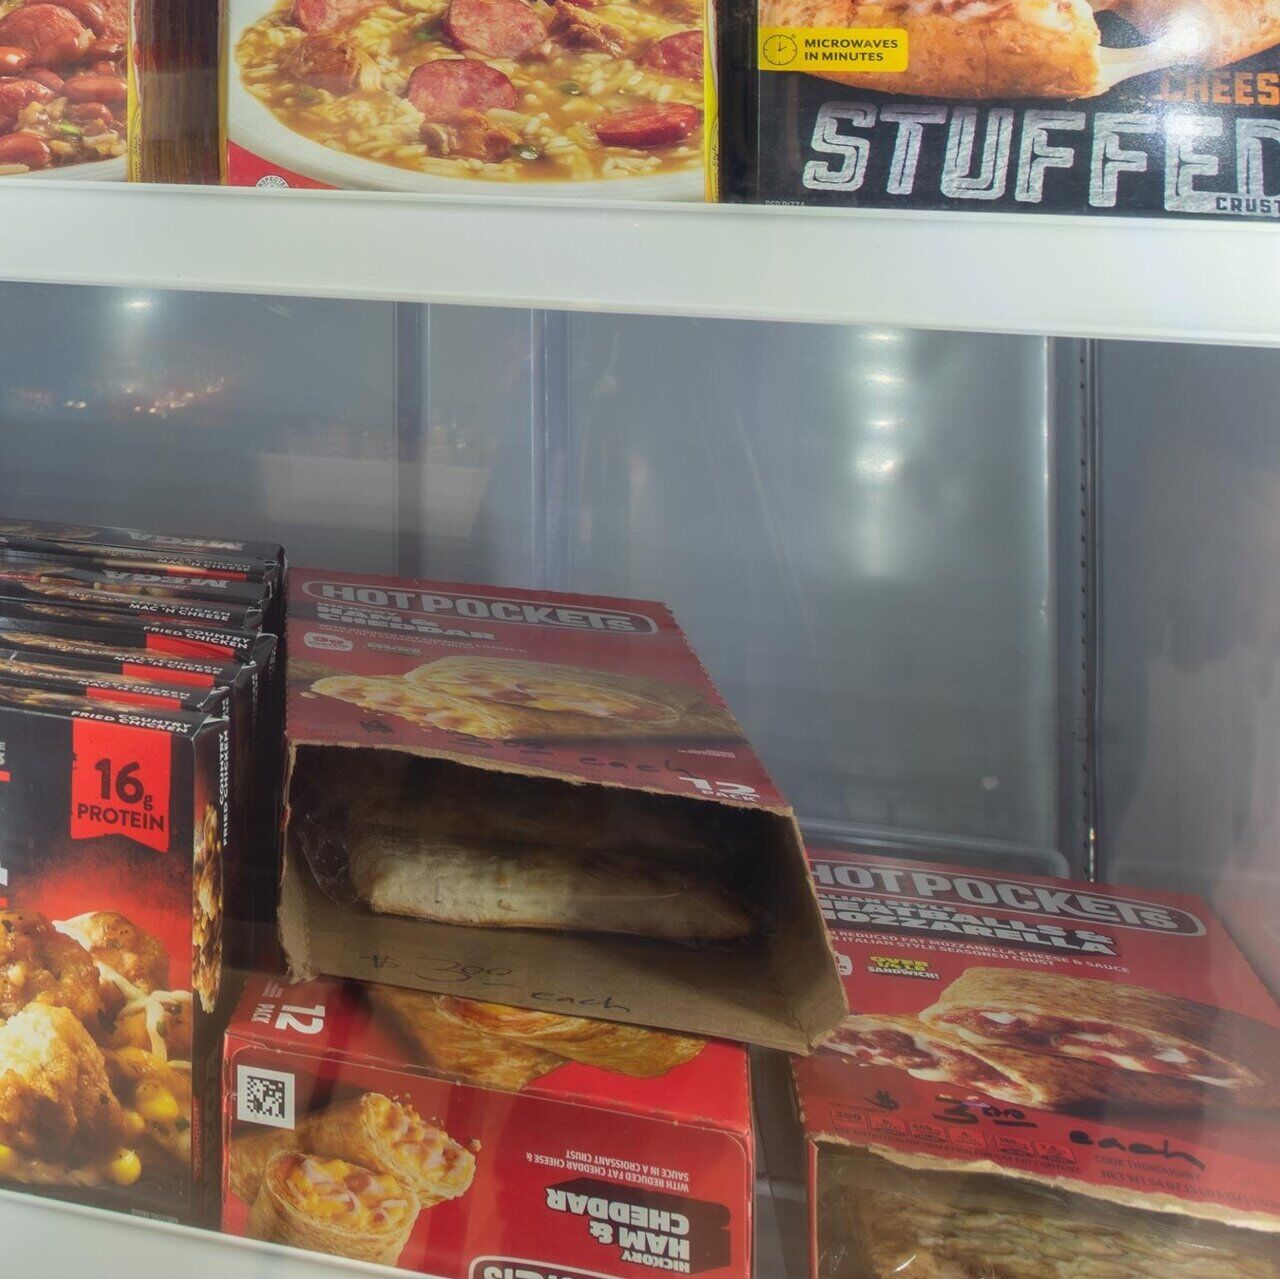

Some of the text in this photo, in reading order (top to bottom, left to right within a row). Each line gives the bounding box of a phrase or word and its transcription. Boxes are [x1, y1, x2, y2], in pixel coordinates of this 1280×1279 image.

[804, 38, 899, 50] MICROWAVES
[804, 51, 884, 63] IN MINUTES
[802, 101, 1280, 214] STUFFED
[321, 584, 416, 609] HOT
[422, 594, 636, 632] POCKETS
[143, 626, 248, 649] FRIED CHICKEN
[184, 629, 251, 644] COUNTRY
[70, 710, 188, 734] FRIED CHICKEN
[118, 714, 192, 728] COUNTRY
[77, 803, 165, 832] PROTEIN
[811, 863, 1180, 931] HOT POCKETS
[850, 937, 1056, 967] ITALIAN STYLE SEASONED CRUST
[532, 990, 631, 1013] each
[275, 1004, 326, 1035] 12
[566, 1149, 592, 1164] CRUST
[1069, 1128, 1206, 1172] each
[534, 1155, 565, 1169] CHEESE
[566, 1160, 606, 1177] CHEDDAR
[593, 1155, 640, 1173] CROISSANT
[653, 1167, 661, 1176] IN
[607, 1168, 624, 1180] FAT
[624, 1172, 665, 1188] REDUCED
[662, 1169, 689, 1182] SAUCE
[666, 1180, 689, 1192] WITH
[546, 1188, 690, 1236] CHEDDAR
[589, 1220, 690, 1260] HAM &
[621, 1250, 690, 1274] HICKORY
